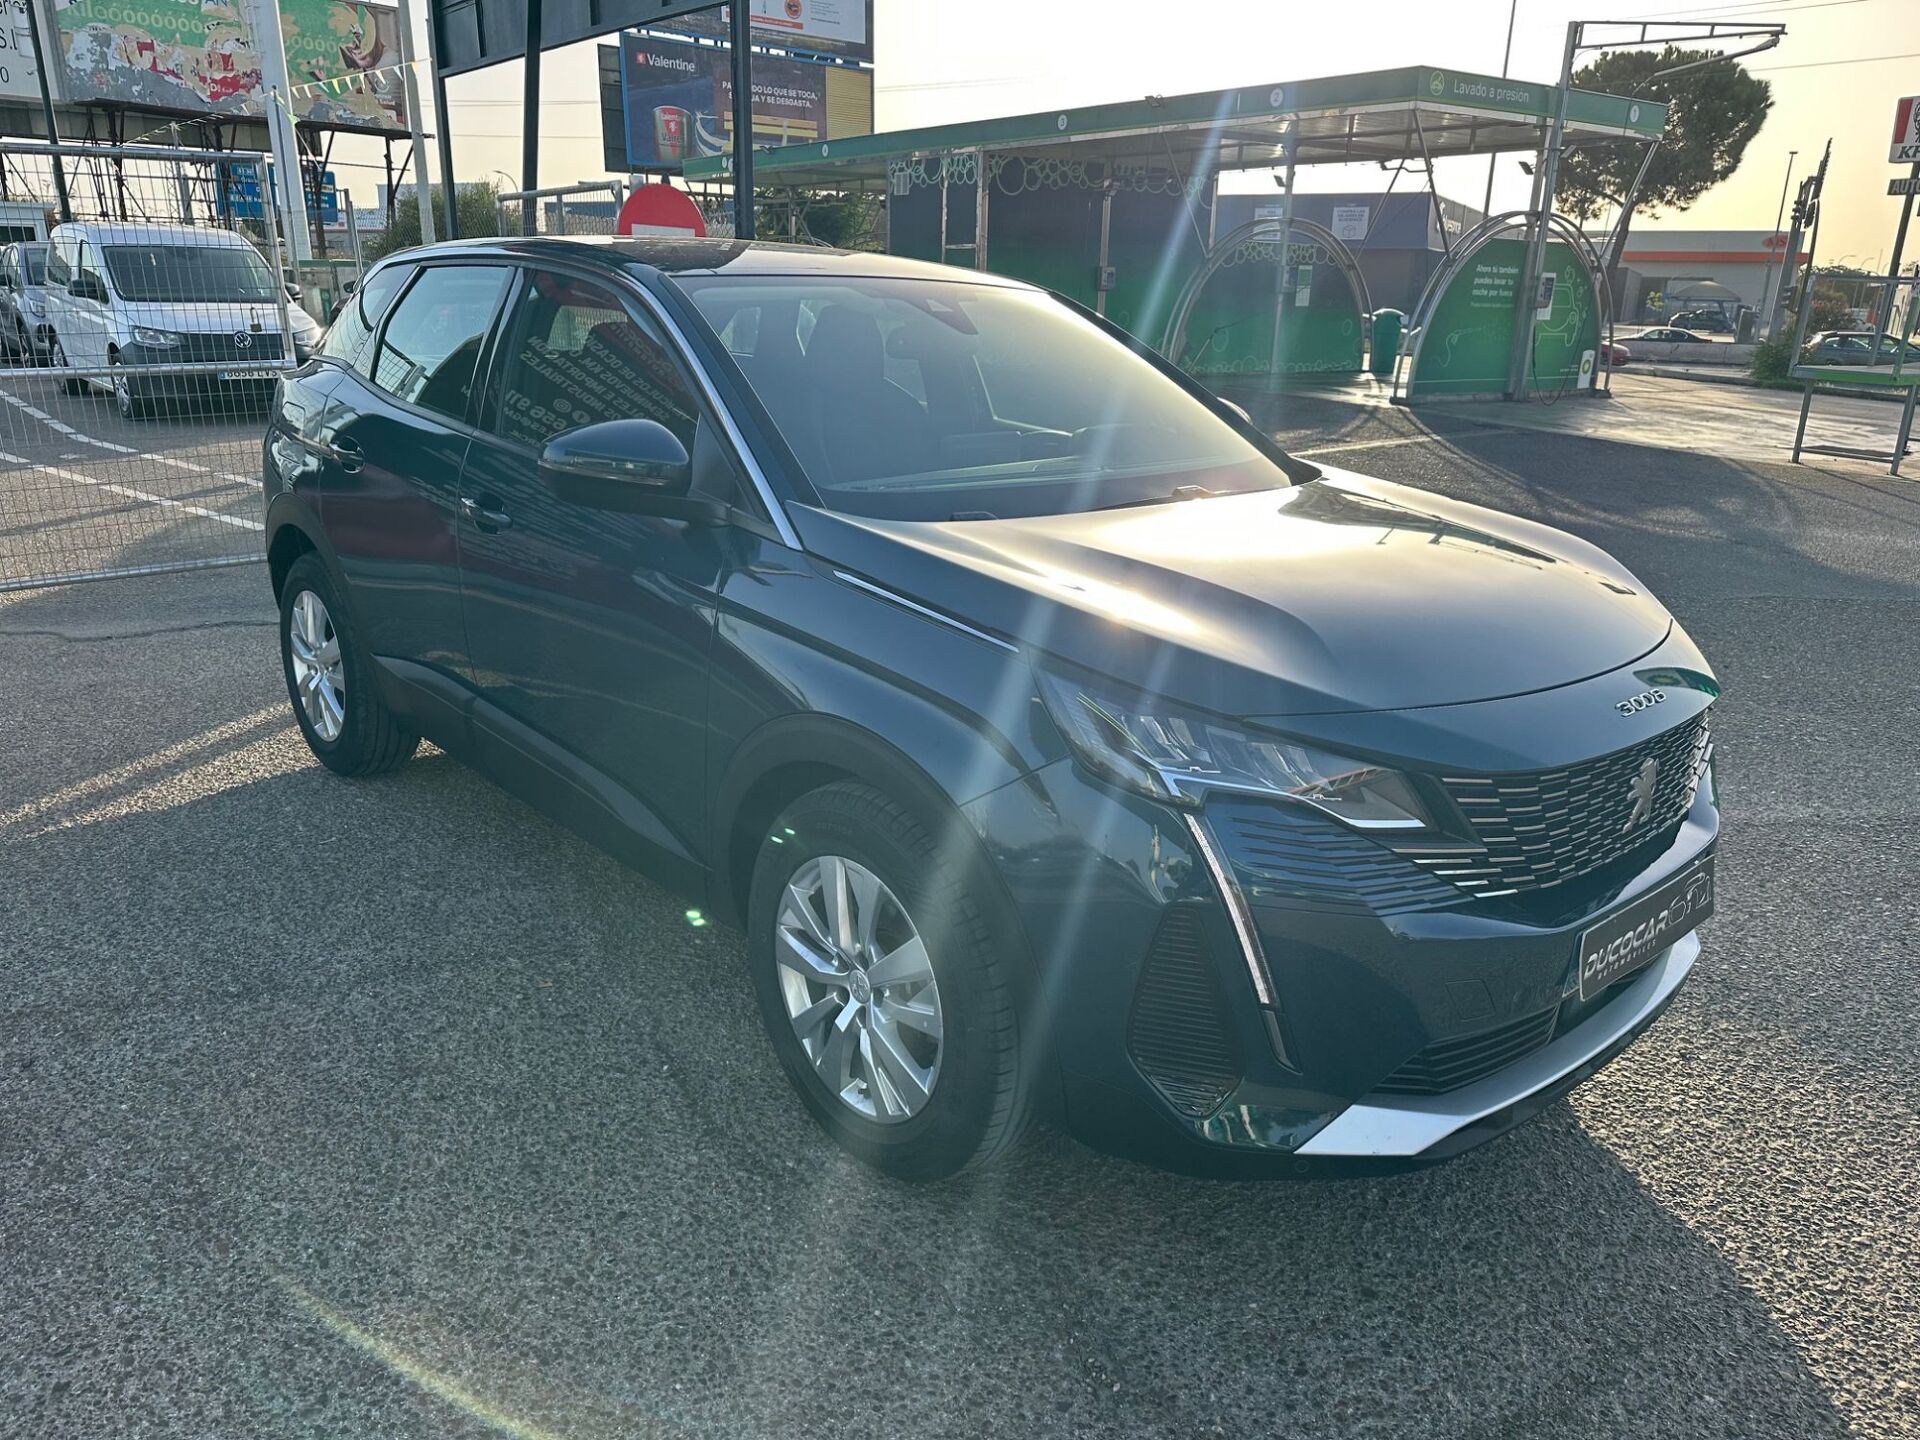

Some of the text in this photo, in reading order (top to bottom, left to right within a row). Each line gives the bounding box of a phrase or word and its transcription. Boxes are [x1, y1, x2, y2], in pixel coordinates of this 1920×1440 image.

[647, 53, 696, 72] Valentine
[763, 86, 773, 94] LO
[773, 87, 788, 96] QUE
[788, 88, 797, 97] SE
[767, 96, 776, 104] SE
[1453, 80, 1529, 103] Lavado a presión
[1584, 909, 1669, 980] DUCOCAR
